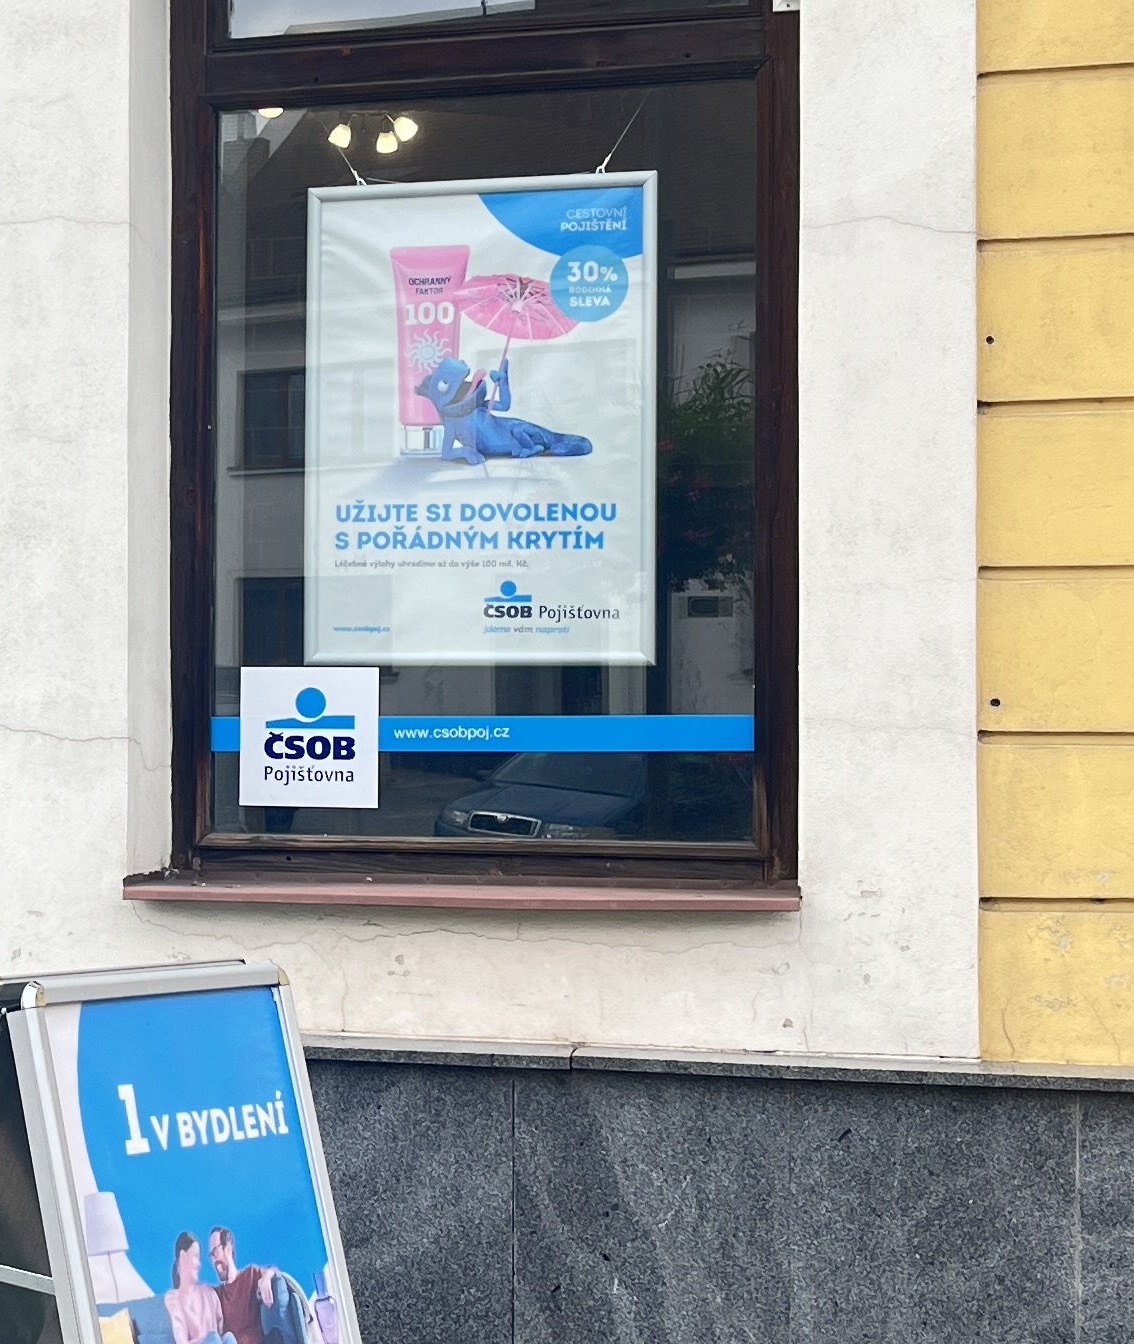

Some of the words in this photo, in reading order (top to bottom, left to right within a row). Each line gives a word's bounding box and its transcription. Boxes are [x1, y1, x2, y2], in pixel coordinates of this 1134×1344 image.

[566, 205, 627, 220] CESTOVNÍ
[560, 217, 627, 233] POJIŠTĚNÍ
[567, 261, 618, 282] 30%
[569, 296, 611, 307] SLEVA
[405, 301, 455, 325] 100
[335, 500, 419, 523] UŽIJTE
[426, 503, 452, 523] SI
[460, 502, 618, 522] DOVOLENOU
[335, 530, 350, 550] S
[357, 525, 499, 551] POŘÁDNÝM
[507, 525, 605, 550] KRYTÍM
[484, 604, 533, 619] ČSOB
[539, 604, 620, 623] Pojišťovna
[393, 725, 510, 741] www.csobpoj.cz
[264, 731, 355, 761] ČSOB
[264, 764, 354, 786] Pojišťovna
[117, 1083, 151, 1155] 1
[150, 1114, 170, 1151] V
[175, 1090, 289, 1147] BYDLENÍ
